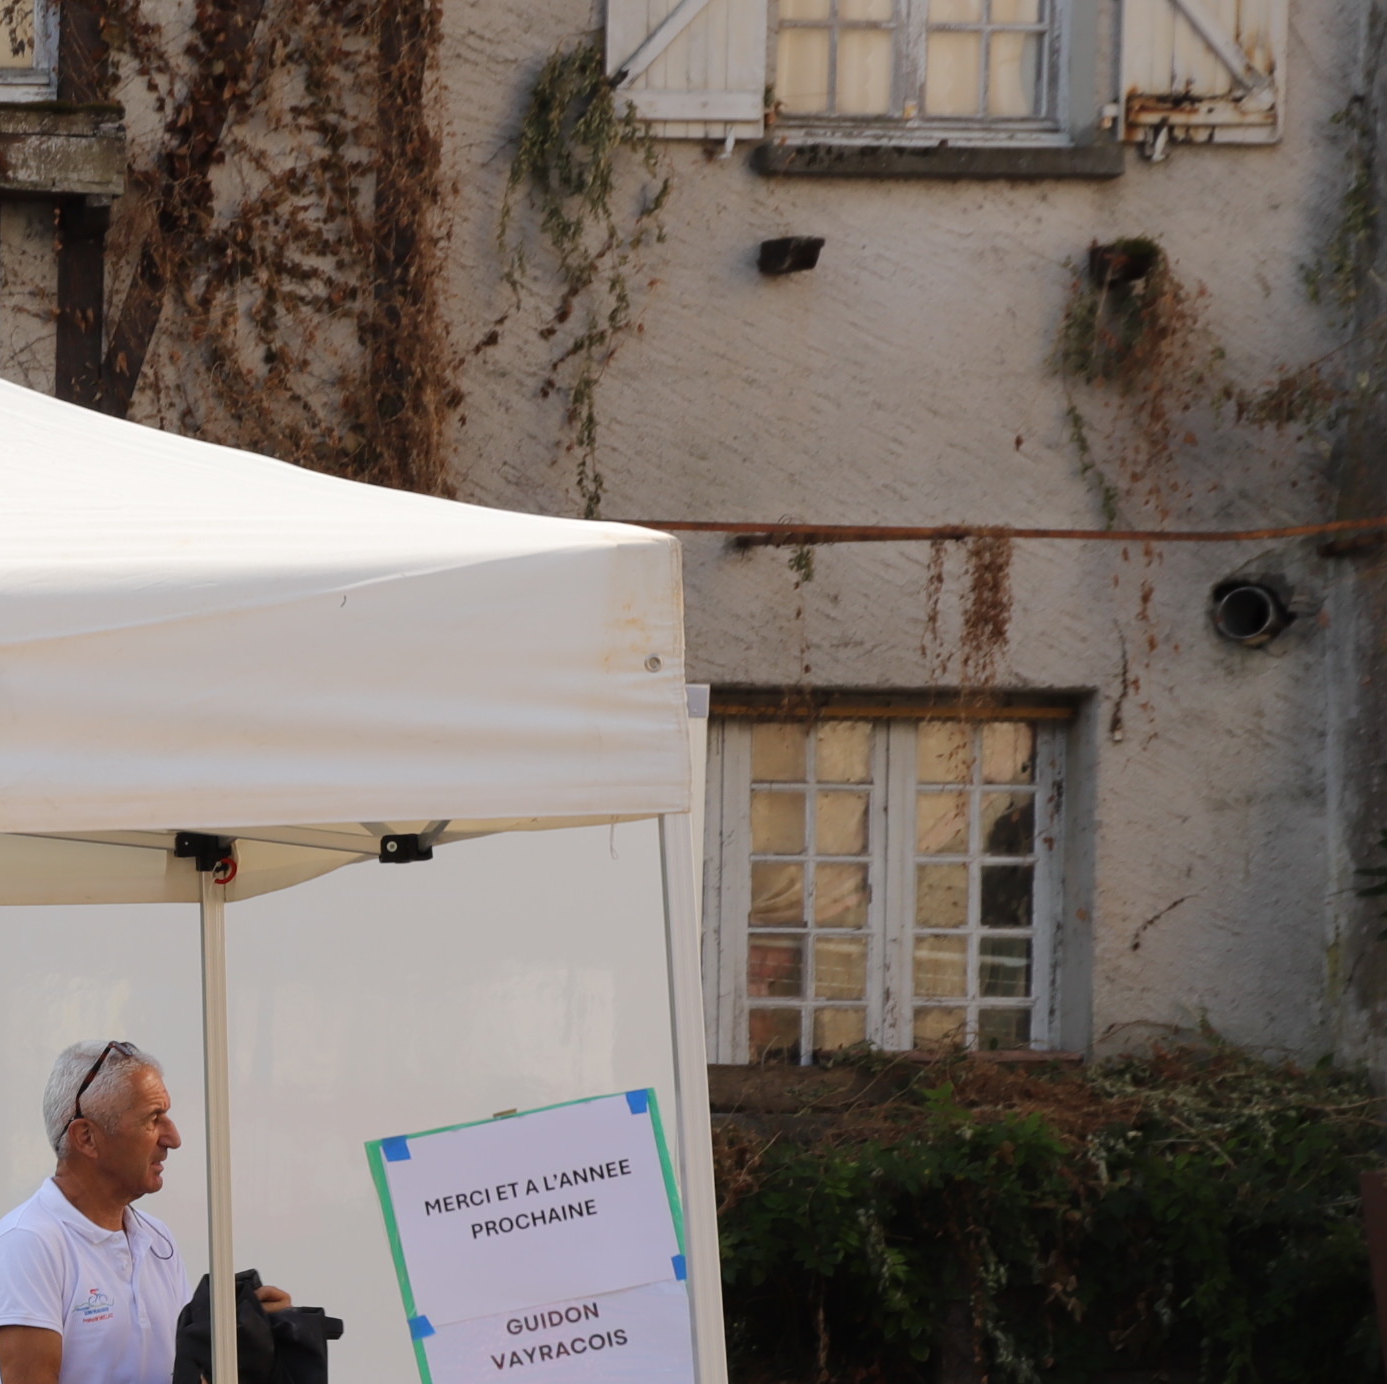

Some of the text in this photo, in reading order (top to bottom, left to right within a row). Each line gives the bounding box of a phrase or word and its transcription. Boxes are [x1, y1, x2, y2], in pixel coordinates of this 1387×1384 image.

[424, 1187, 491, 1216] MERCI
[497, 1183, 519, 1202] ET
[525, 1179, 540, 1196] A
[470, 1199, 598, 1239] PROCHAINE
[506, 1302, 600, 1336] GUIDON
[491, 1328, 628, 1371] VAYRACOIS
